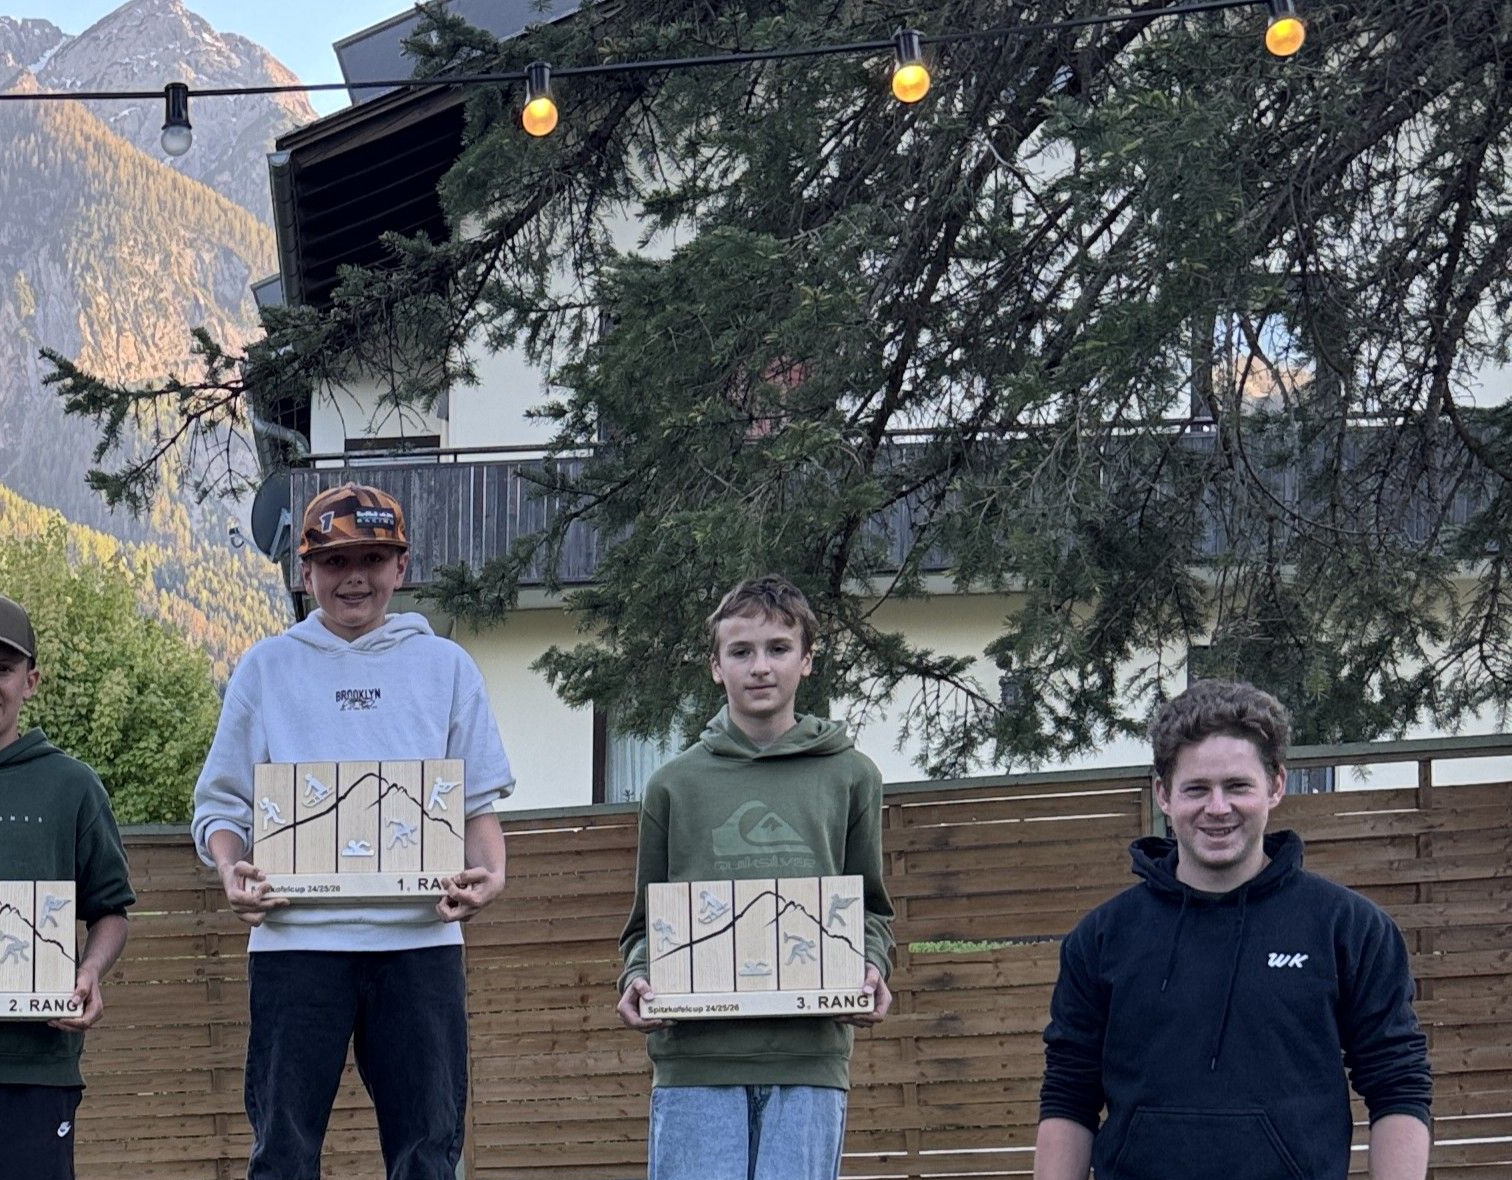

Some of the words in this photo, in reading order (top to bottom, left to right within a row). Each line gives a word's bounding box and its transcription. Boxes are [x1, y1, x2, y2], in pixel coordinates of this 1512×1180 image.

[319, 510, 335, 534] 1
[335, 688, 381, 702] BROOKLYN
[397, 878, 411, 892] 1.
[418, 877, 467, 891] RAG
[1268, 952, 1309, 968] WK
[9, 999, 23, 1012] 2.
[29, 999, 78, 1012] RANG
[796, 996, 811, 1010] 3.
[817, 995, 870, 1009] RANG
